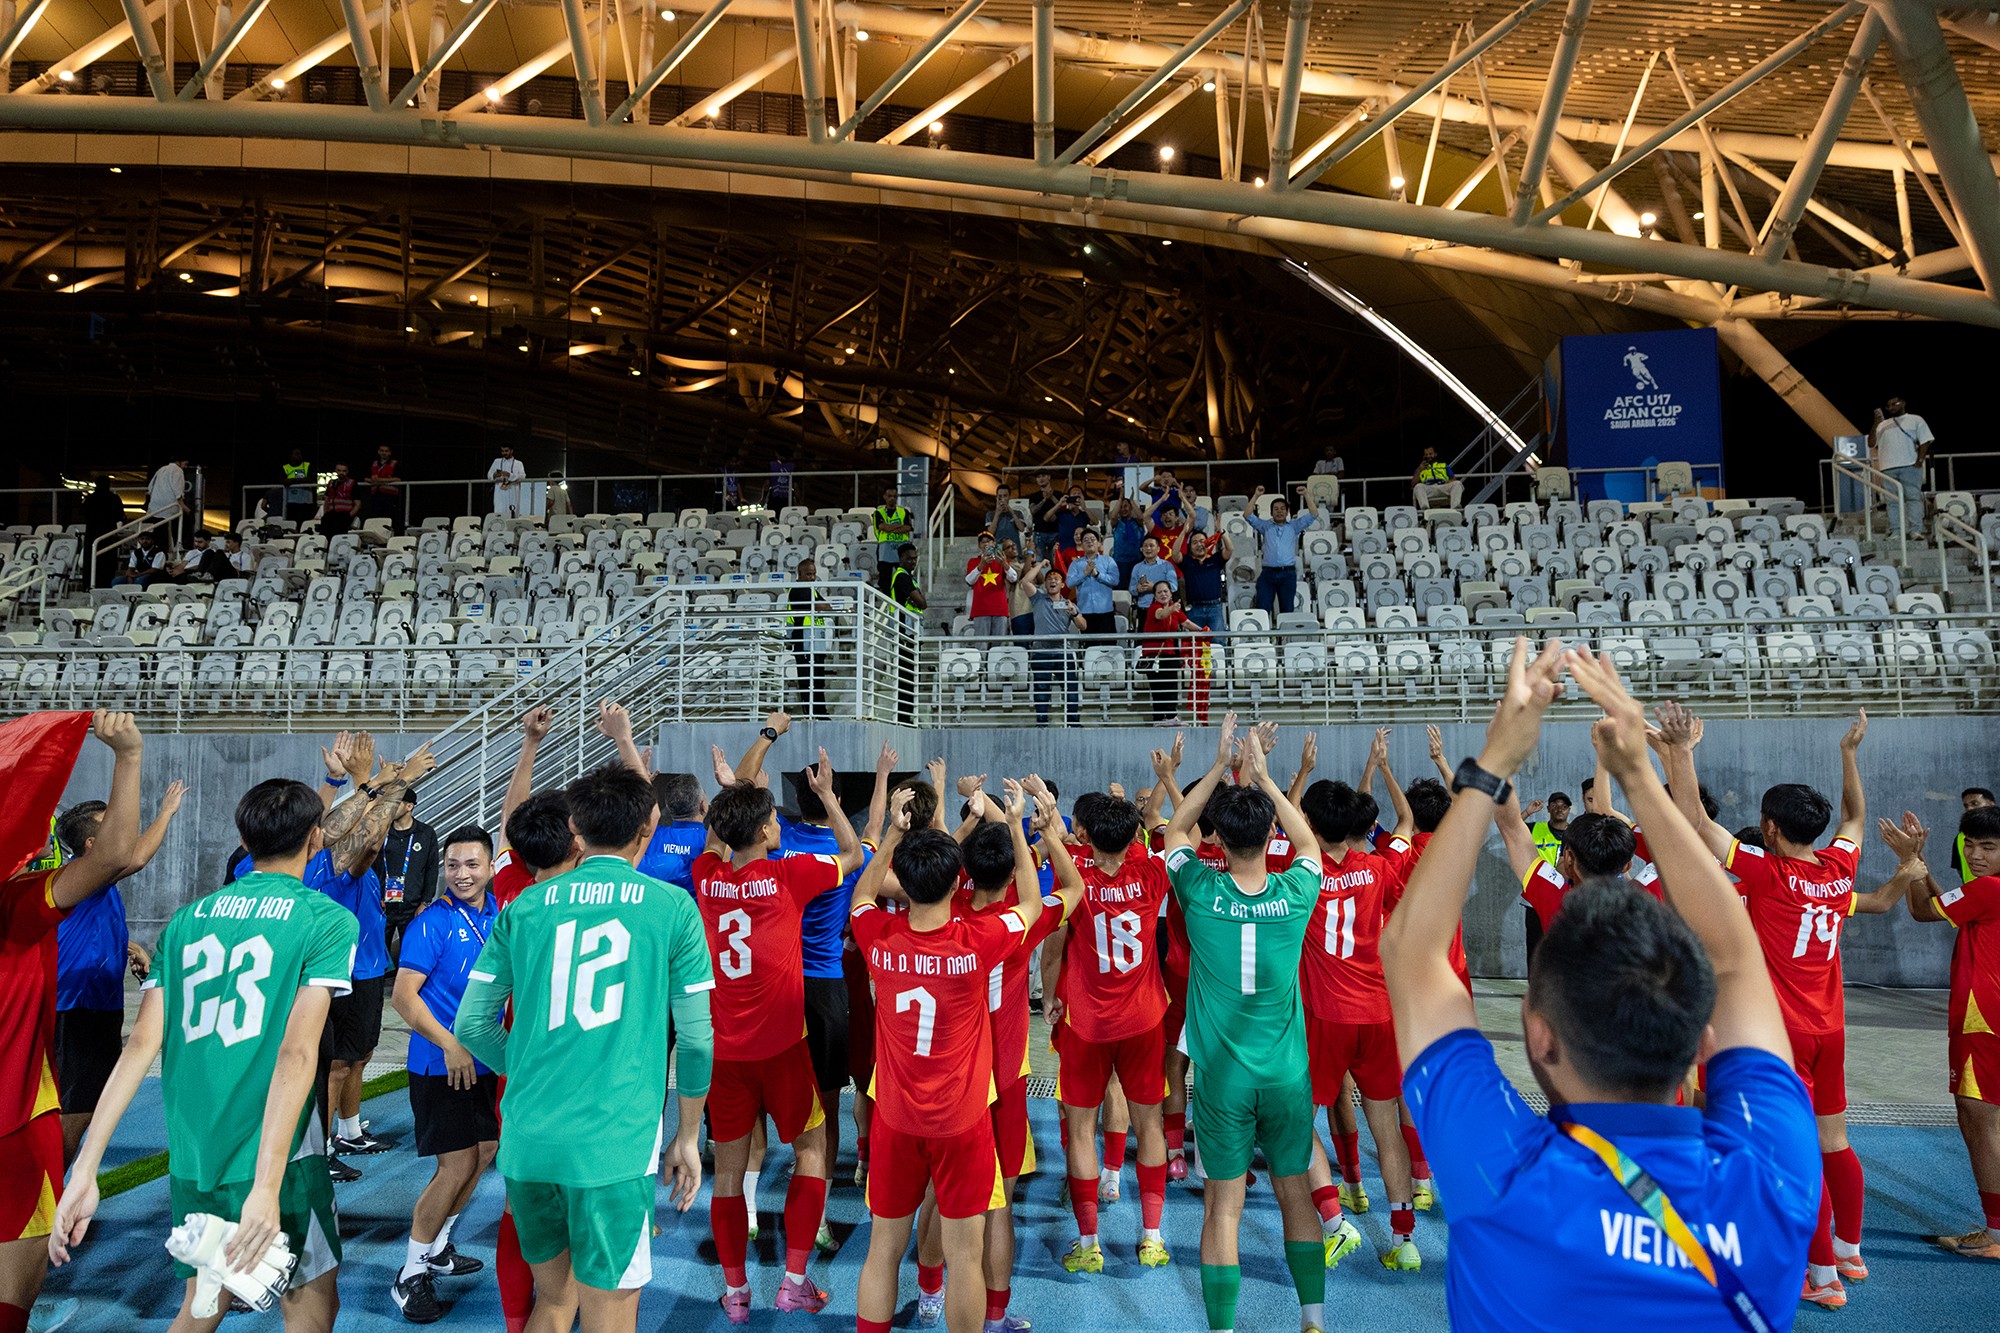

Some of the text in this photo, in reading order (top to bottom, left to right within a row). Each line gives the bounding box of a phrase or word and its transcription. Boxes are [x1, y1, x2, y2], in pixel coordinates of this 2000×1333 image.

[1604, 405, 1682, 420] ASIAN CUP
[1613, 394, 1671, 407] AFC U17
[1610, 418, 1677, 429] SAUDI ARABIA 2026
[1846, 442, 1858, 457] B
[908, 464, 918, 477] C
[663, 843, 690, 855] VIETNAM
[1199, 858, 1224, 871] UYEN
[545, 881, 645, 906] N. TUAN VU
[741, 877, 778, 899] CUONG
[1087, 881, 1142, 902] T. DINH VY
[255, 896, 295, 921] HOA
[1213, 896, 1290, 918] C. BA HUAN
[1325, 896, 1356, 960] 11
[1792, 903, 1841, 961] 14
[718, 908, 752, 980] 3
[1094, 909, 1143, 974] 18
[872, 947, 977, 975] N. H. D. VIET NAM
[1240, 922, 1256, 995] 1
[548, 918, 631, 1032] 12
[181, 933, 274, 1048] 23
[896, 986, 936, 1056] 7
[1600, 1208, 1743, 1269] VIETM
